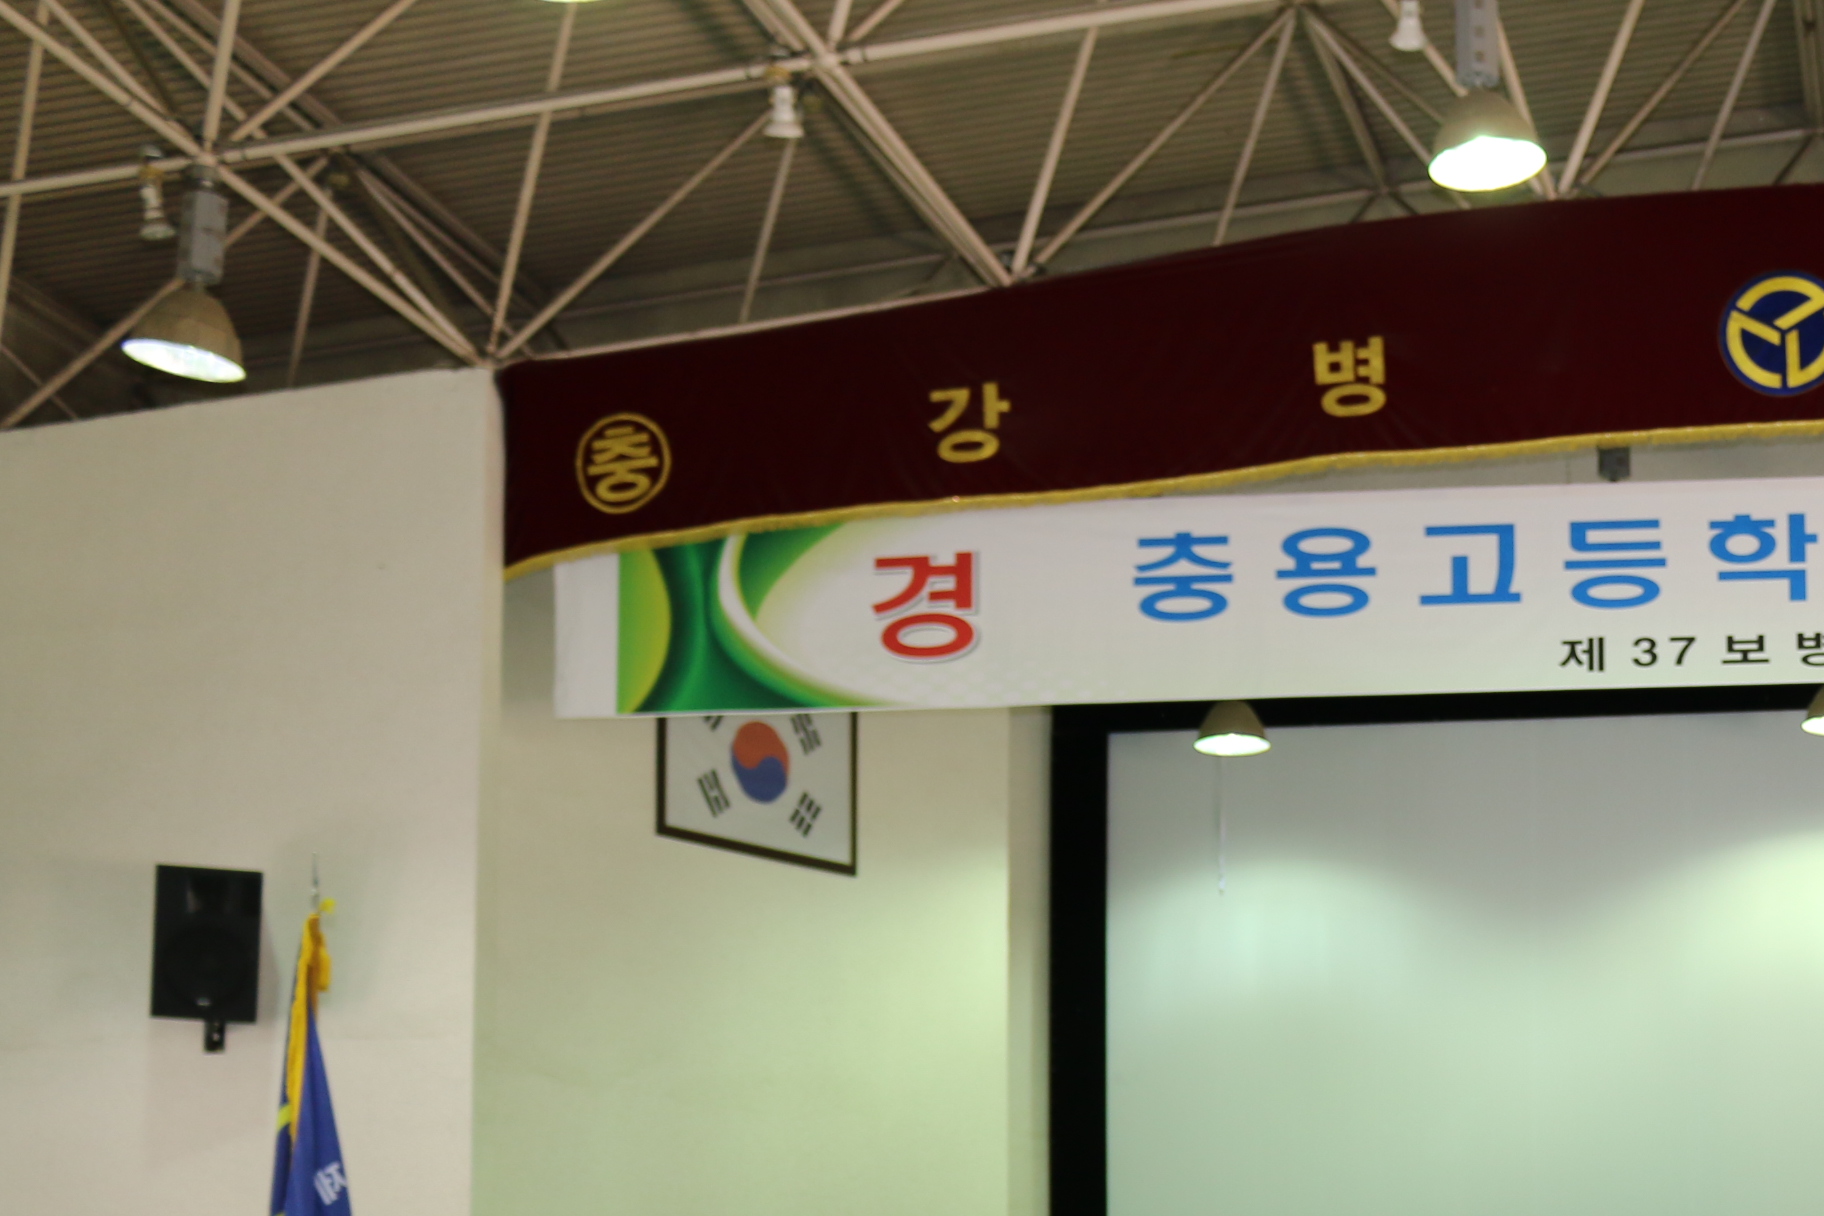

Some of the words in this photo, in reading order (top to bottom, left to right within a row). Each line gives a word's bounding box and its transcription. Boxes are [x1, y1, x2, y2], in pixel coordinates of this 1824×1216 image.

[583, 422, 662, 505] 충
[929, 381, 1013, 464] 강
[1311, 335, 1388, 418] 병
[872, 551, 980, 663] 경
